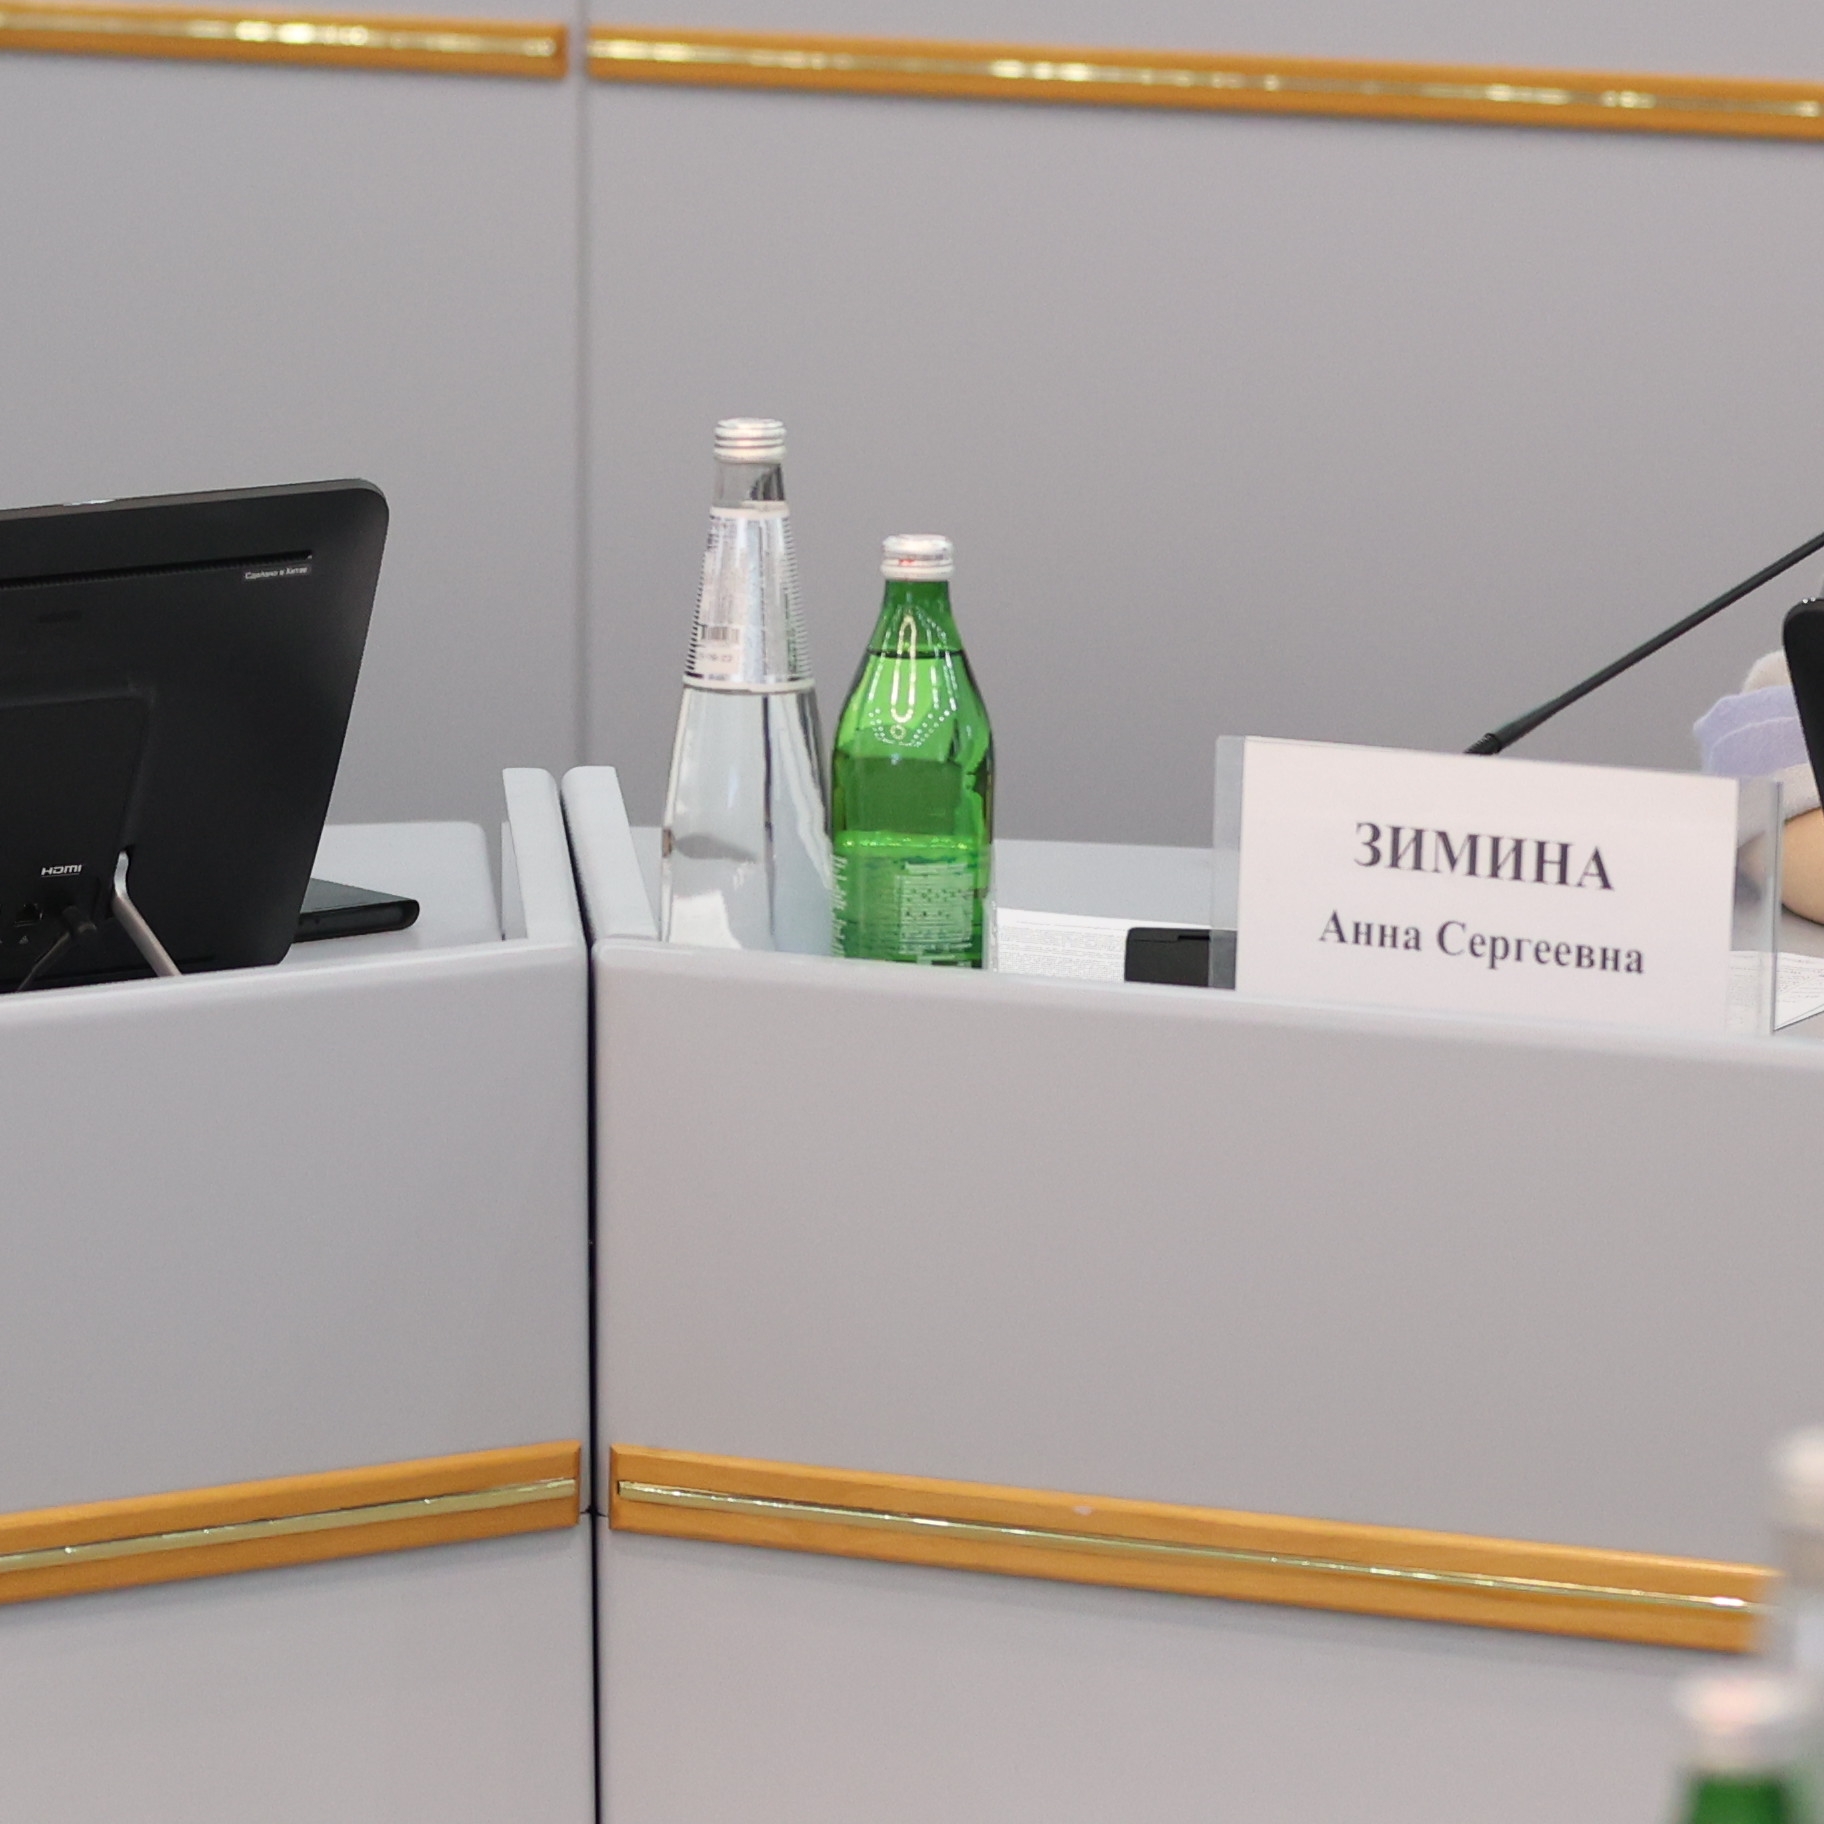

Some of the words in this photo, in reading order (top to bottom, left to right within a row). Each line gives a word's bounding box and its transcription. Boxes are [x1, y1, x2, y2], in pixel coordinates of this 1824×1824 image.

[40, 863, 83, 876] HDMI
[1353, 821, 1614, 891] ЗИМИНА
[1318, 909, 1422, 952] Анна
[1436, 920, 1645, 975] Сергеевна
